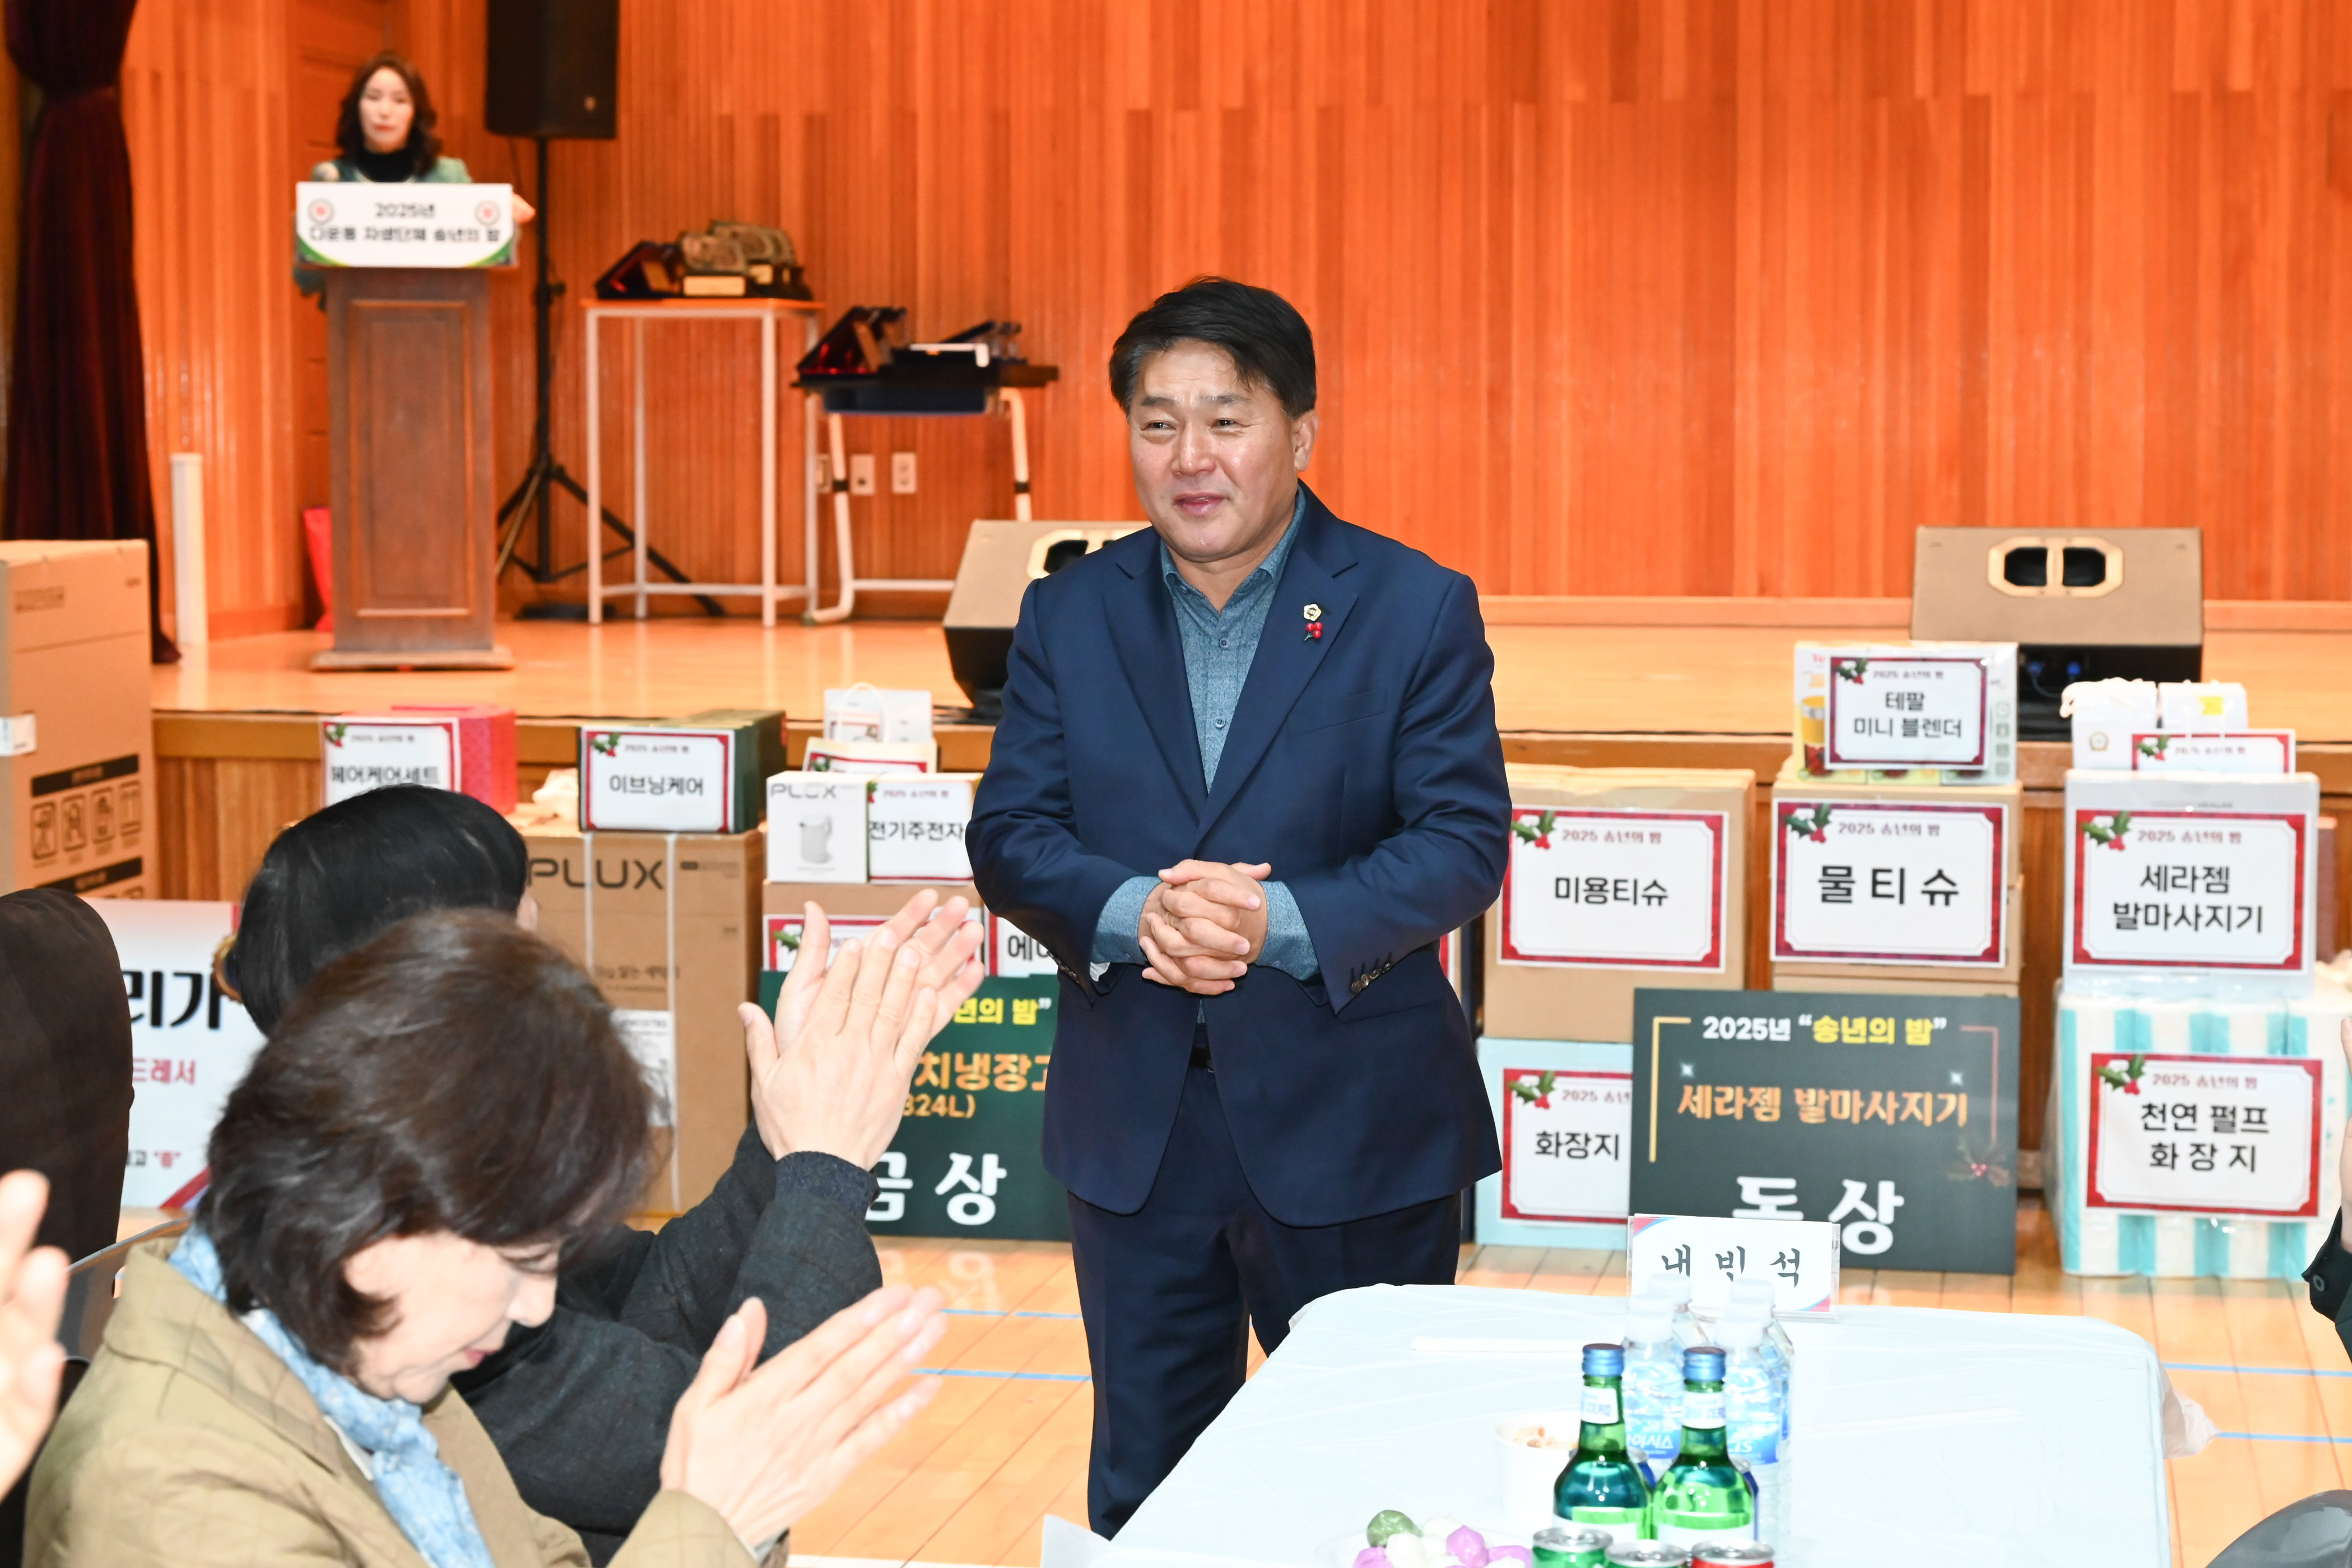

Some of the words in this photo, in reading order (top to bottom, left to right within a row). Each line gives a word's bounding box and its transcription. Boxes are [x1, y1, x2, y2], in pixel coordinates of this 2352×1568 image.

[1885, 691, 1925, 712] 테팔
[1853, 717, 1894, 738] 미니
[1901, 718, 1962, 738] 블렌더
[609, 774, 704, 796] 이브닝케어
[870, 820, 964, 841] 전기주전자
[1562, 829, 1598, 842] 2025
[1603, 830, 1644, 844] 송년의
[1649, 831, 1662, 844] 밤
[1838, 822, 1875, 835] 2025
[1880, 823, 1922, 836] 송년의
[1927, 824, 1940, 837] 밤
[2137, 829, 2176, 843] 2025
[2181, 830, 2224, 844] 송년의
[2228, 831, 2242, 844] 밤
[527, 858, 664, 890] PLUX
[1818, 865, 1959, 907] 물티슈
[2140, 864, 2230, 894] 세라젬
[1555, 877, 1668, 907] 미용티슈
[2113, 902, 2263, 934] 발마사지기
[1008, 936, 1049, 961] 에
[1702, 1016, 1791, 1042] 2025년
[2152, 1073, 2191, 1087] 2025
[2196, 1074, 2239, 1089] 송년의
[2244, 1077, 2258, 1090] 밤
[1561, 1089, 1598, 1102] 2025
[1677, 1084, 1782, 1123] 세라젬
[1794, 1085, 1969, 1128] 발마사지기
[2141, 1102, 2197, 1132] 천연
[2210, 1105, 2269, 1134] 펄프
[1535, 1130, 1620, 1161] 화장지
[2150, 1142, 2256, 1173] 화장지
